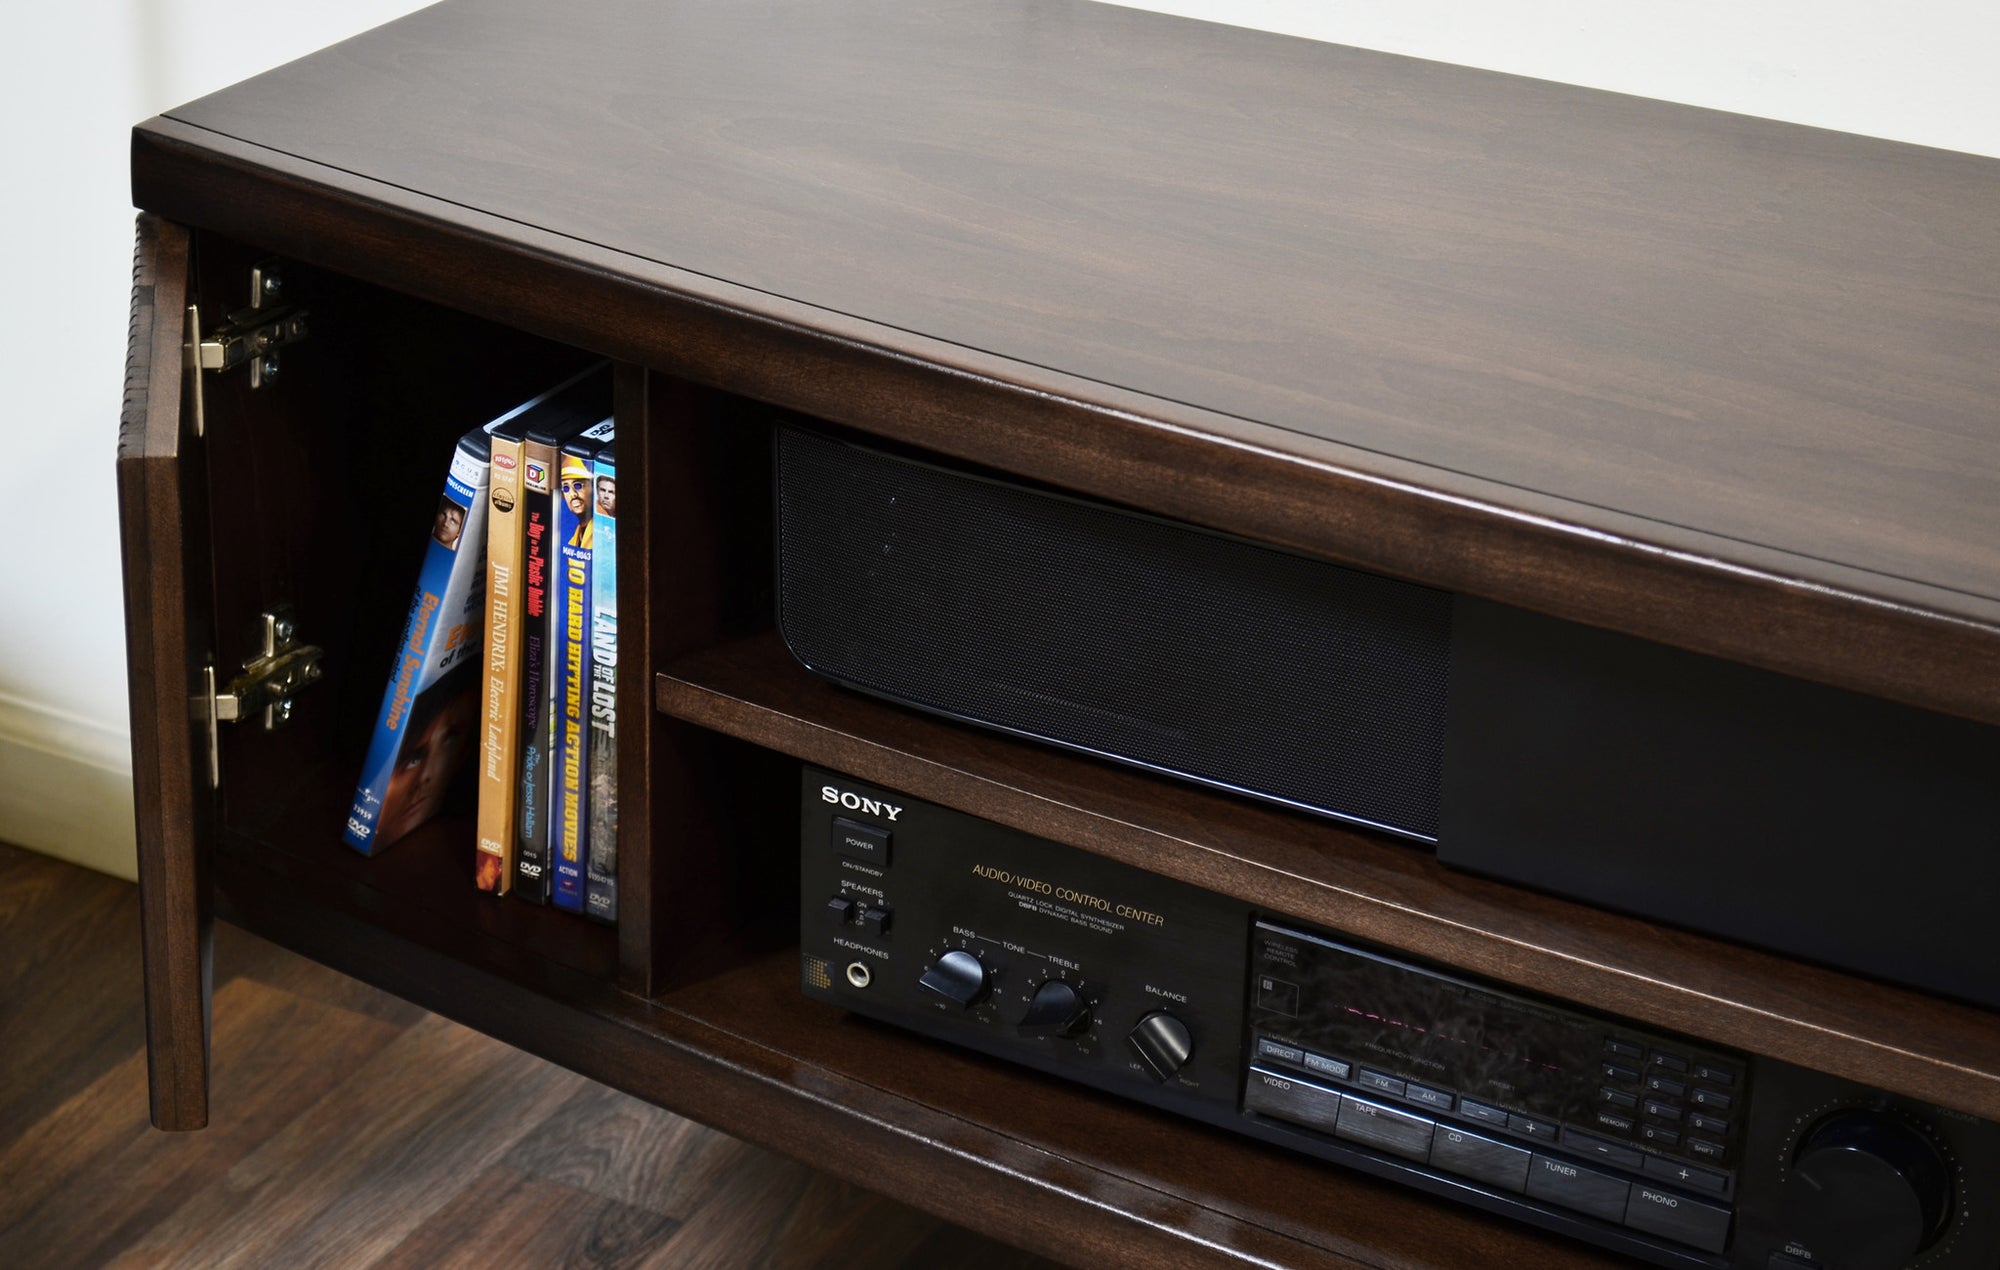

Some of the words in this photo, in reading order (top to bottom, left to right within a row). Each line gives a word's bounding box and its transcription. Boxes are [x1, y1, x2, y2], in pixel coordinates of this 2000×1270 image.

[527, 522, 545, 540] Boy
[492, 561, 510, 597] JIMI
[528, 555, 545, 586] Plastic
[567, 558, 586, 586] 10
[528, 586, 544, 618] Bubble
[408, 591, 440, 656] Eternal
[567, 586, 584, 642] HARD
[490, 599, 508, 672] HENDRIX:
[592, 605, 618, 667] LAND
[528, 635, 541, 668] Eliza's
[566, 641, 583, 720] HITTING
[386, 654, 422, 732] Sunshine
[488, 676, 505, 720] Electric
[525, 670, 540, 729] Horoscope
[591, 680, 618, 738] LOST
[484, 719, 502, 782] Ladyland
[526, 746, 536, 771] Pride
[564, 720, 581, 791] ACTION
[822, 786, 902, 821] SONY
[347, 816, 371, 837] DVD
[562, 791, 580, 862] MOVIES
[481, 838, 501, 851] DVD
[846, 838, 874, 850] POWER
[520, 861, 542, 875] DVD
[558, 866, 578, 878] ACTION
[842, 861, 883, 878] ON/STANDBY
[589, 892, 610, 906] DVD
[841, 880, 884, 898] SPEAKERS
[972, 864, 1052, 895] AUDIO/VIDEO
[1055, 887, 1114, 914] CONTROL
[1116, 904, 1164, 928] CENTER
[856, 900, 867, 908] ON
[1008, 891, 1034, 904] QUARTZ
[1036, 899, 1054, 910] LOCK
[1055, 904, 1080, 918] DIGITAL
[1080, 913, 1126, 932] SYNTHESIZER
[1038, 908, 1070, 922] DYNAMIC
[1070, 916, 1088, 928] BASS
[1089, 922, 1114, 936] SOUND
[833, 937, 889, 960] HEADPHONES
[953, 926, 976, 939] BASS
[1002, 941, 1026, 954] TONE
[1048, 955, 1080, 972] TREBLE
[1266, 948, 1295, 960] REMOTE
[1264, 953, 1297, 968] CONTROL
[1144, 984, 1188, 1004] BALANCE
[1266, 1045, 1295, 1060] DIRECT
[1306, 1058, 1320, 1068] FM
[1322, 1062, 1346, 1076] MODE
[1263, 1076, 1291, 1090] VIDEO
[1376, 1078, 1389, 1088] FM
[1422, 1092, 1436, 1102] AM
[1354, 1103, 1377, 1116] TAPE
[1600, 1116, 1630, 1129] MEMORY
[1448, 1132, 1462, 1144] CD
[1694, 1144, 1715, 1156] SHIFT
[1544, 1160, 1577, 1178] TUNER
[1642, 1190, 1678, 1208] PHONO
[1785, 1244, 1812, 1260] DBFB
